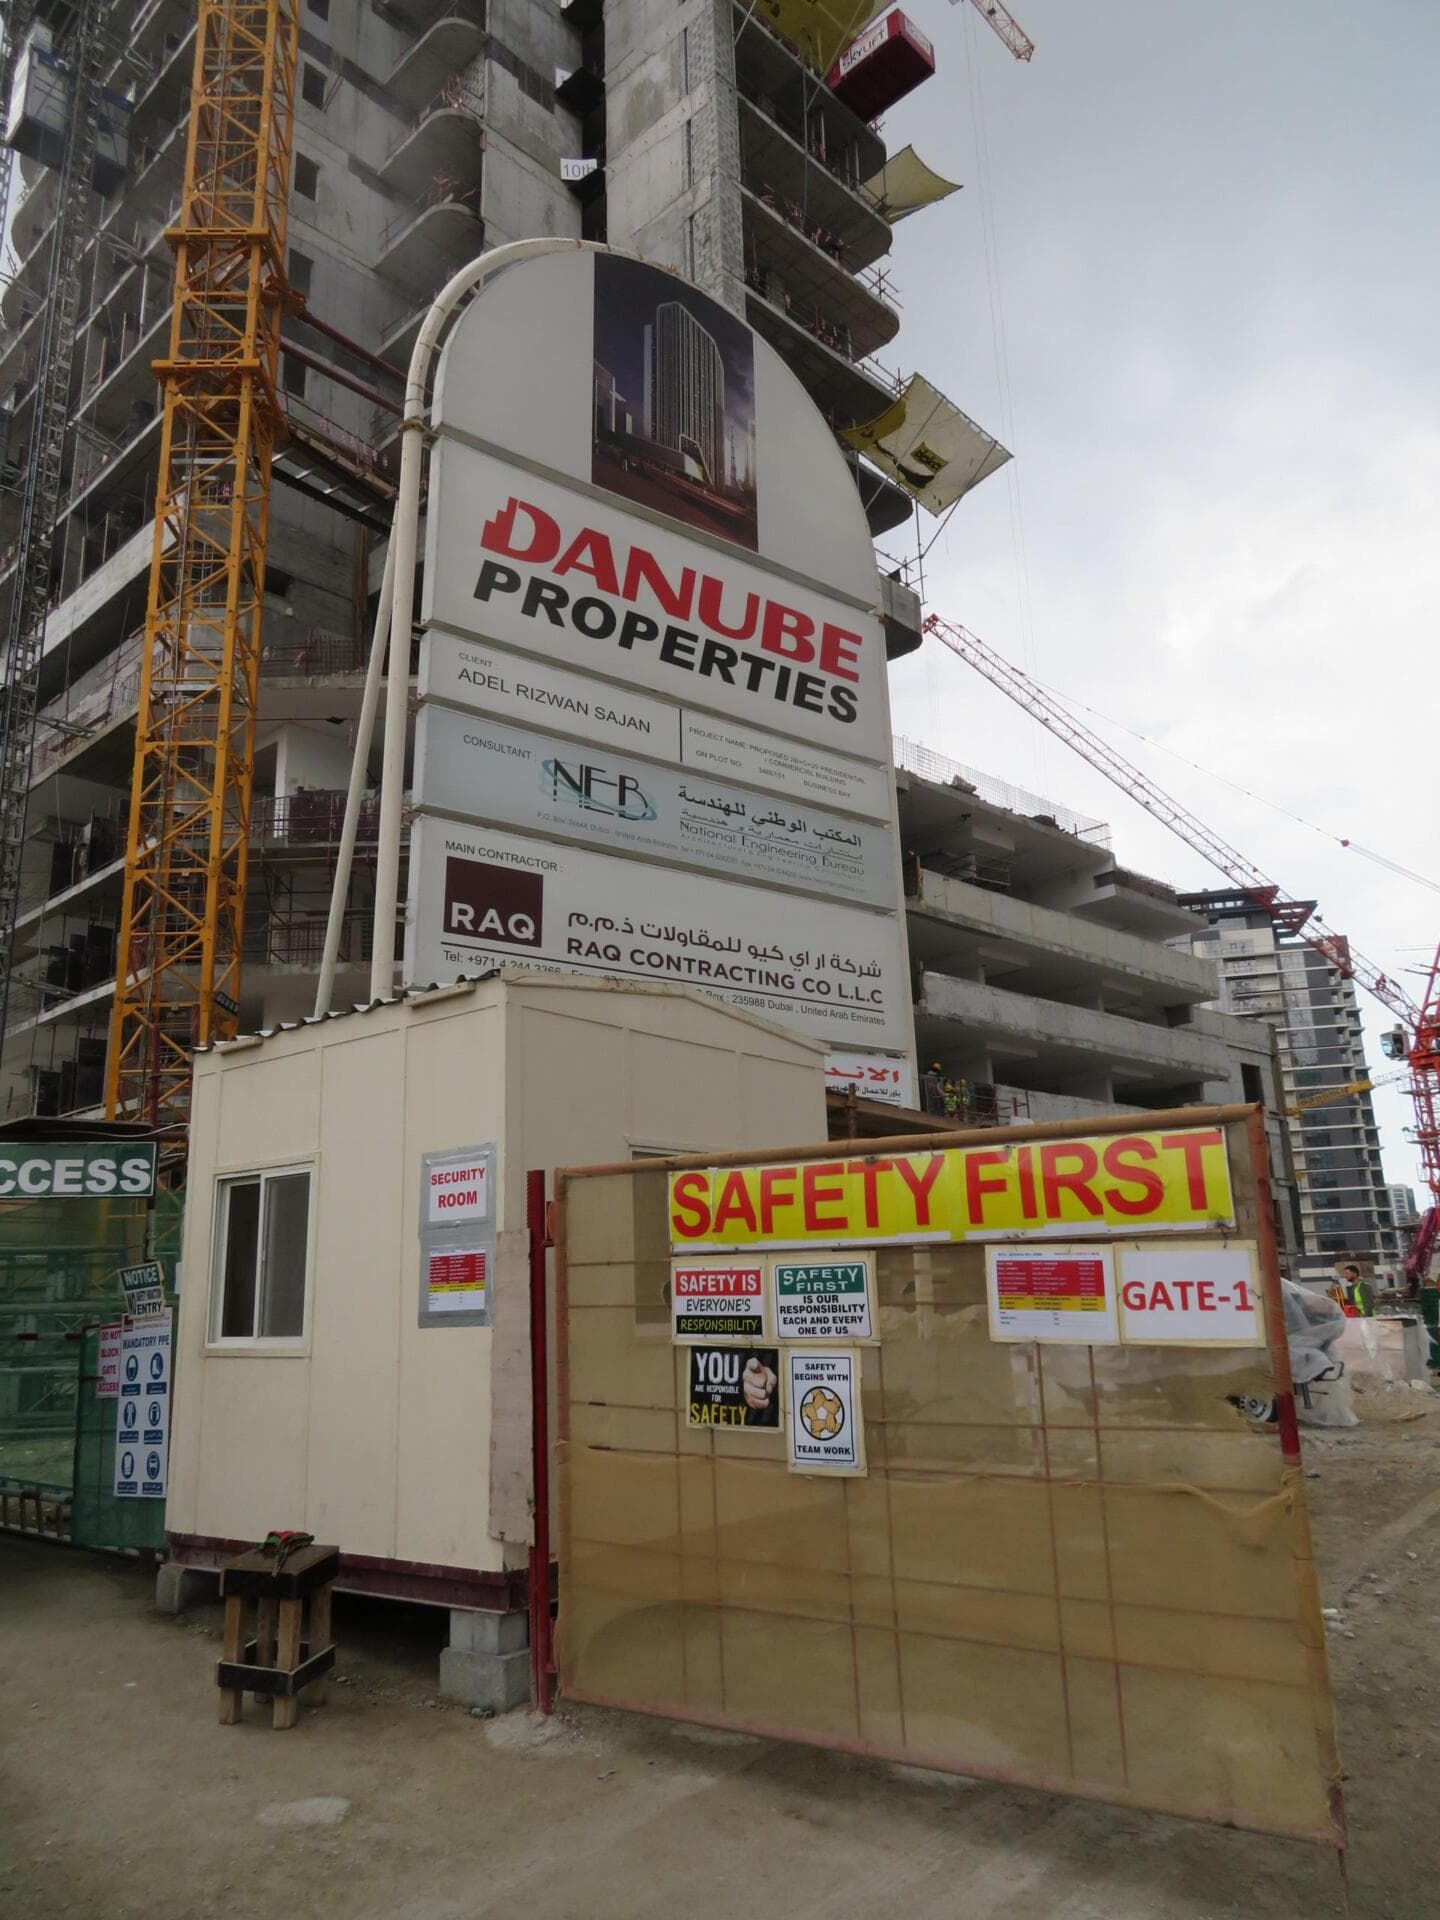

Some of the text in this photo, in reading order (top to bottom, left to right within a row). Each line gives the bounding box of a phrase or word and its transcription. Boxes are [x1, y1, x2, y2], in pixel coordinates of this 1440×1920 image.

[480, 496, 863, 683] DANUBE
[472, 559, 859, 724] PROPERTIES
[458, 668, 651, 733] ADEL RIZWAN SAJAN
[463, 734, 531, 760] CONSULTANT
[677, 785, 862, 848] المكتب الوطني للهندسة
[445, 840, 558, 872] MAIN CONTRACTOR
[680, 820, 736, 844] National
[742, 835, 817, 866] Engineering
[822, 855, 865, 876] Bureau
[451, 901, 536, 941] RAQ
[640, 923, 742, 952] للمقاولات
[443, 950, 463, 963] Tel:
[467, 953, 495, 968] +971
[747, 942, 784, 963] كيو
[567, 937, 884, 1004] RAQ CONTRACTING CO L.L.C
[830, 953, 882, 979] شركة
[768, 999, 794, 1012] Dubai
[800, 1004, 828, 1017] United
[829, 1009, 849, 1020] Arab
[851, 1012, 886, 1026] Emirates
[431, 1167, 485, 1185] SECURITY
[671, 1132, 1222, 1238] SAFETY FIRST
[438, 1190, 478, 1208] ROOM
[123, 1266, 158, 1287] NOTICE
[679, 1273, 757, 1293] SAFETY IS
[783, 1267, 859, 1286] SAFETY
[796, 1280, 849, 1292] FIRST
[686, 1298, 751, 1312] EVERYONE'S
[803, 1294, 840, 1304] IS OUR
[1122, 1280, 1254, 1312] GATE-1
[137, 1301, 162, 1315] ENTRY
[779, 1303, 866, 1315] RESPONSIBILITY
[680, 1318, 759, 1332] RESPONSIBILITY
[782, 1315, 864, 1325] EACH AND EVERY
[797, 1325, 849, 1335] ONE OF US
[123, 1335, 170, 1349] MANDATORY PPE
[695, 1351, 740, 1384] YOU
[804, 1363, 837, 1371] SAFETY
[794, 1373, 849, 1382] BEGINS WITH
[694, 1384, 740, 1394] ARE RESPONSIBLE
[711, 1394, 722, 1403] FOR
[690, 1403, 748, 1426] SAFETY
[797, 1445, 851, 1455] TEAM WORK
